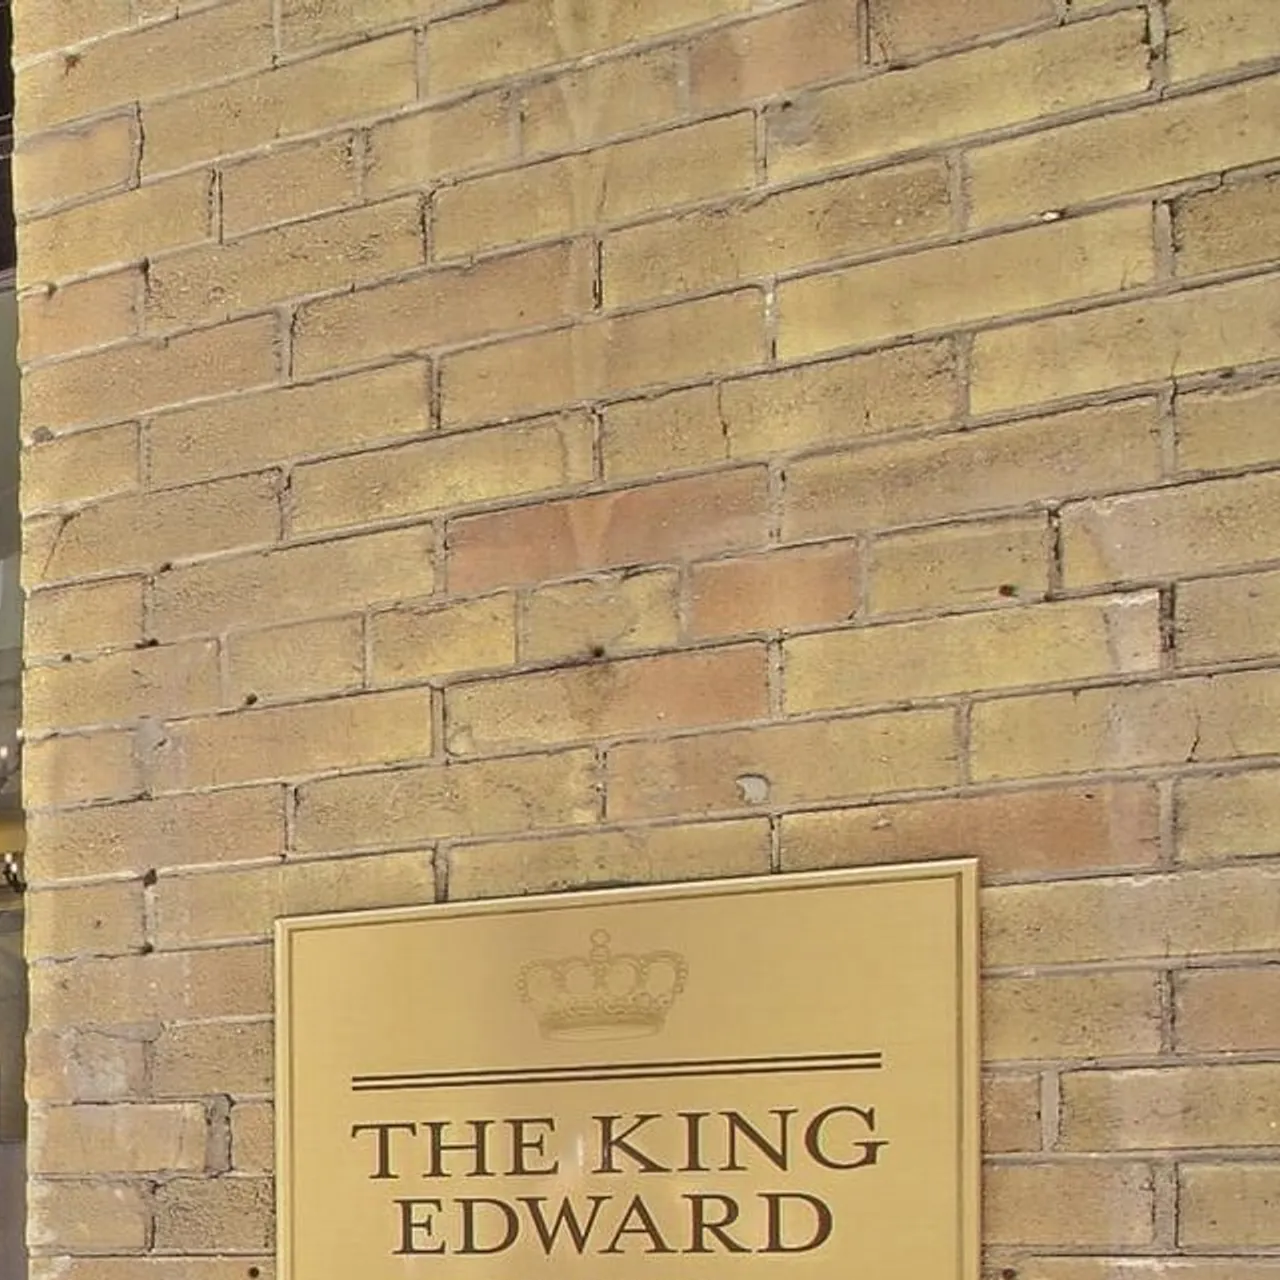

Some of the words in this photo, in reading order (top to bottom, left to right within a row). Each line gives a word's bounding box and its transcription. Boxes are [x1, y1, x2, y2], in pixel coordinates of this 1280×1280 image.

[351, 1116, 560, 1180] THE
[591, 1105, 890, 1175] KING
[391, 1190, 835, 1257] EDWARD
